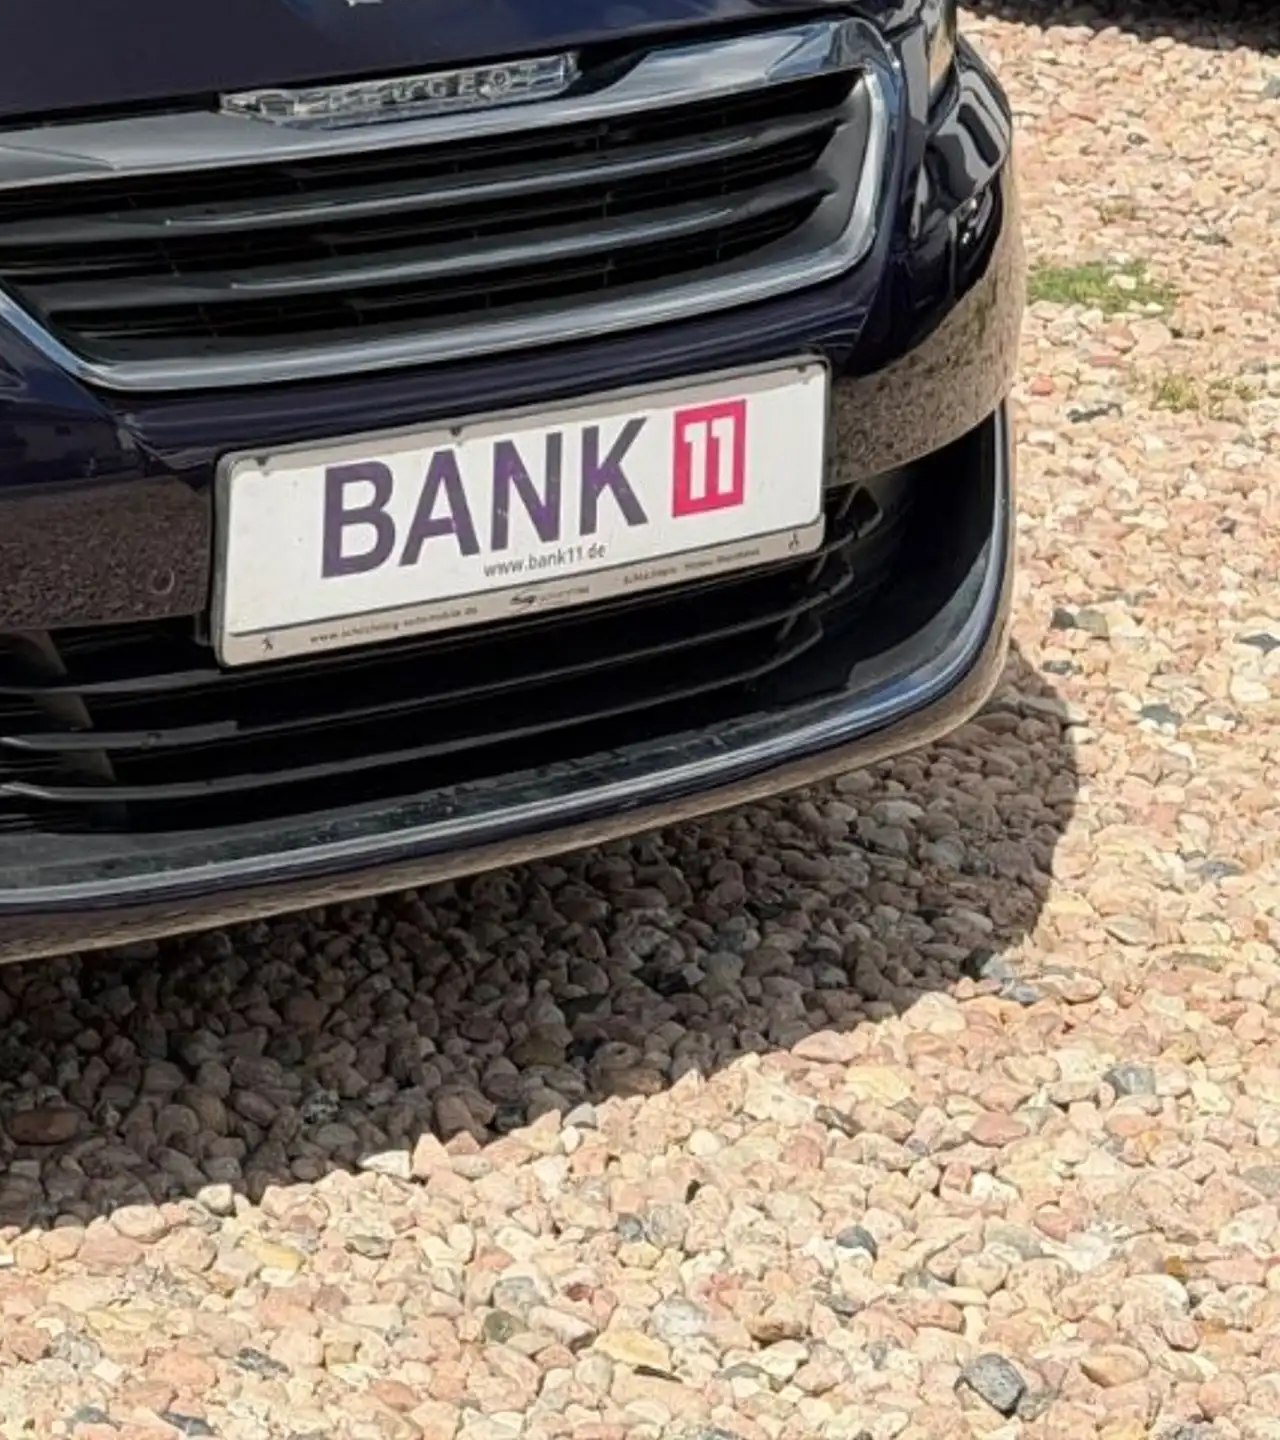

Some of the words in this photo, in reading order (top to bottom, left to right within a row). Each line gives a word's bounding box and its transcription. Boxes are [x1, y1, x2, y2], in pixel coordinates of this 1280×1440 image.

[320, 416, 650, 580] BANK
[678, 408, 740, 507] 11
[482, 541, 607, 579] www.bank11.de
